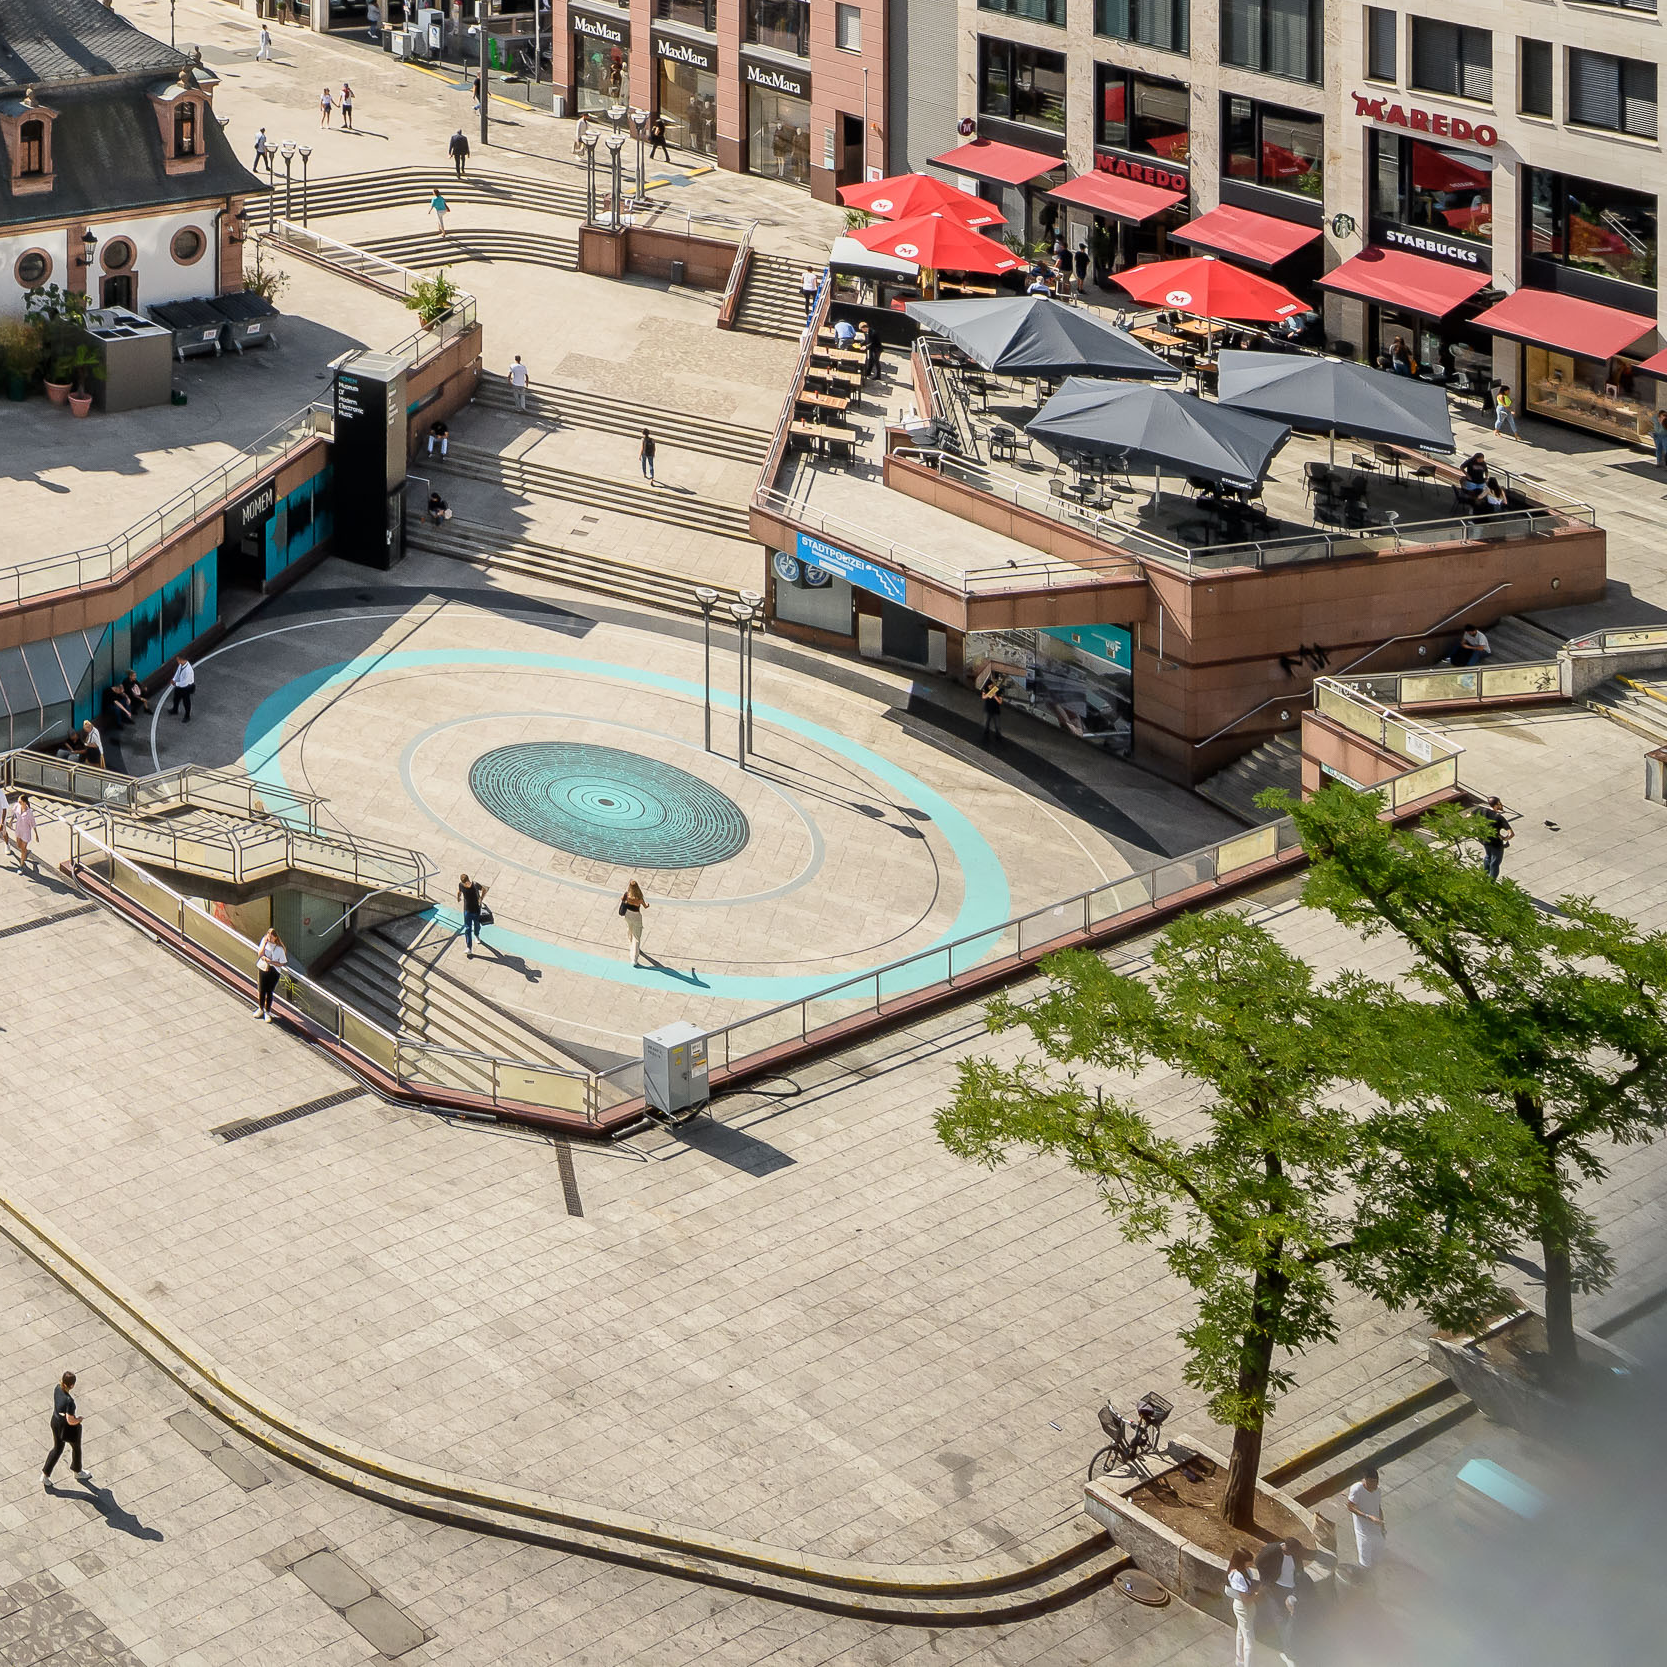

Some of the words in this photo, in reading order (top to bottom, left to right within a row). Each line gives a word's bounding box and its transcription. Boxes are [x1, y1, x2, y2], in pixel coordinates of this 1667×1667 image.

[574, 15, 621, 42] MaxMara
[657, 39, 707, 67] MaxMara
[747, 65, 800, 94] MaxMara
[1351, 91, 1498, 147] MAREDO
[1095, 152, 1188, 190] MAREDO
[1385, 229, 1478, 264] STARBUCKS
[338, 382, 359, 392] Museum
[338, 395, 358, 406] Modern
[338, 402, 364, 415] Electronic
[338, 409, 353, 419] Music
[1419, 443, 1451, 455] STARBUCKS
[1221, 477, 1253, 489] STARBUCKS
[242, 488, 273, 526] MOMEM
[801, 536, 865, 571] STADTPOLIZEI
